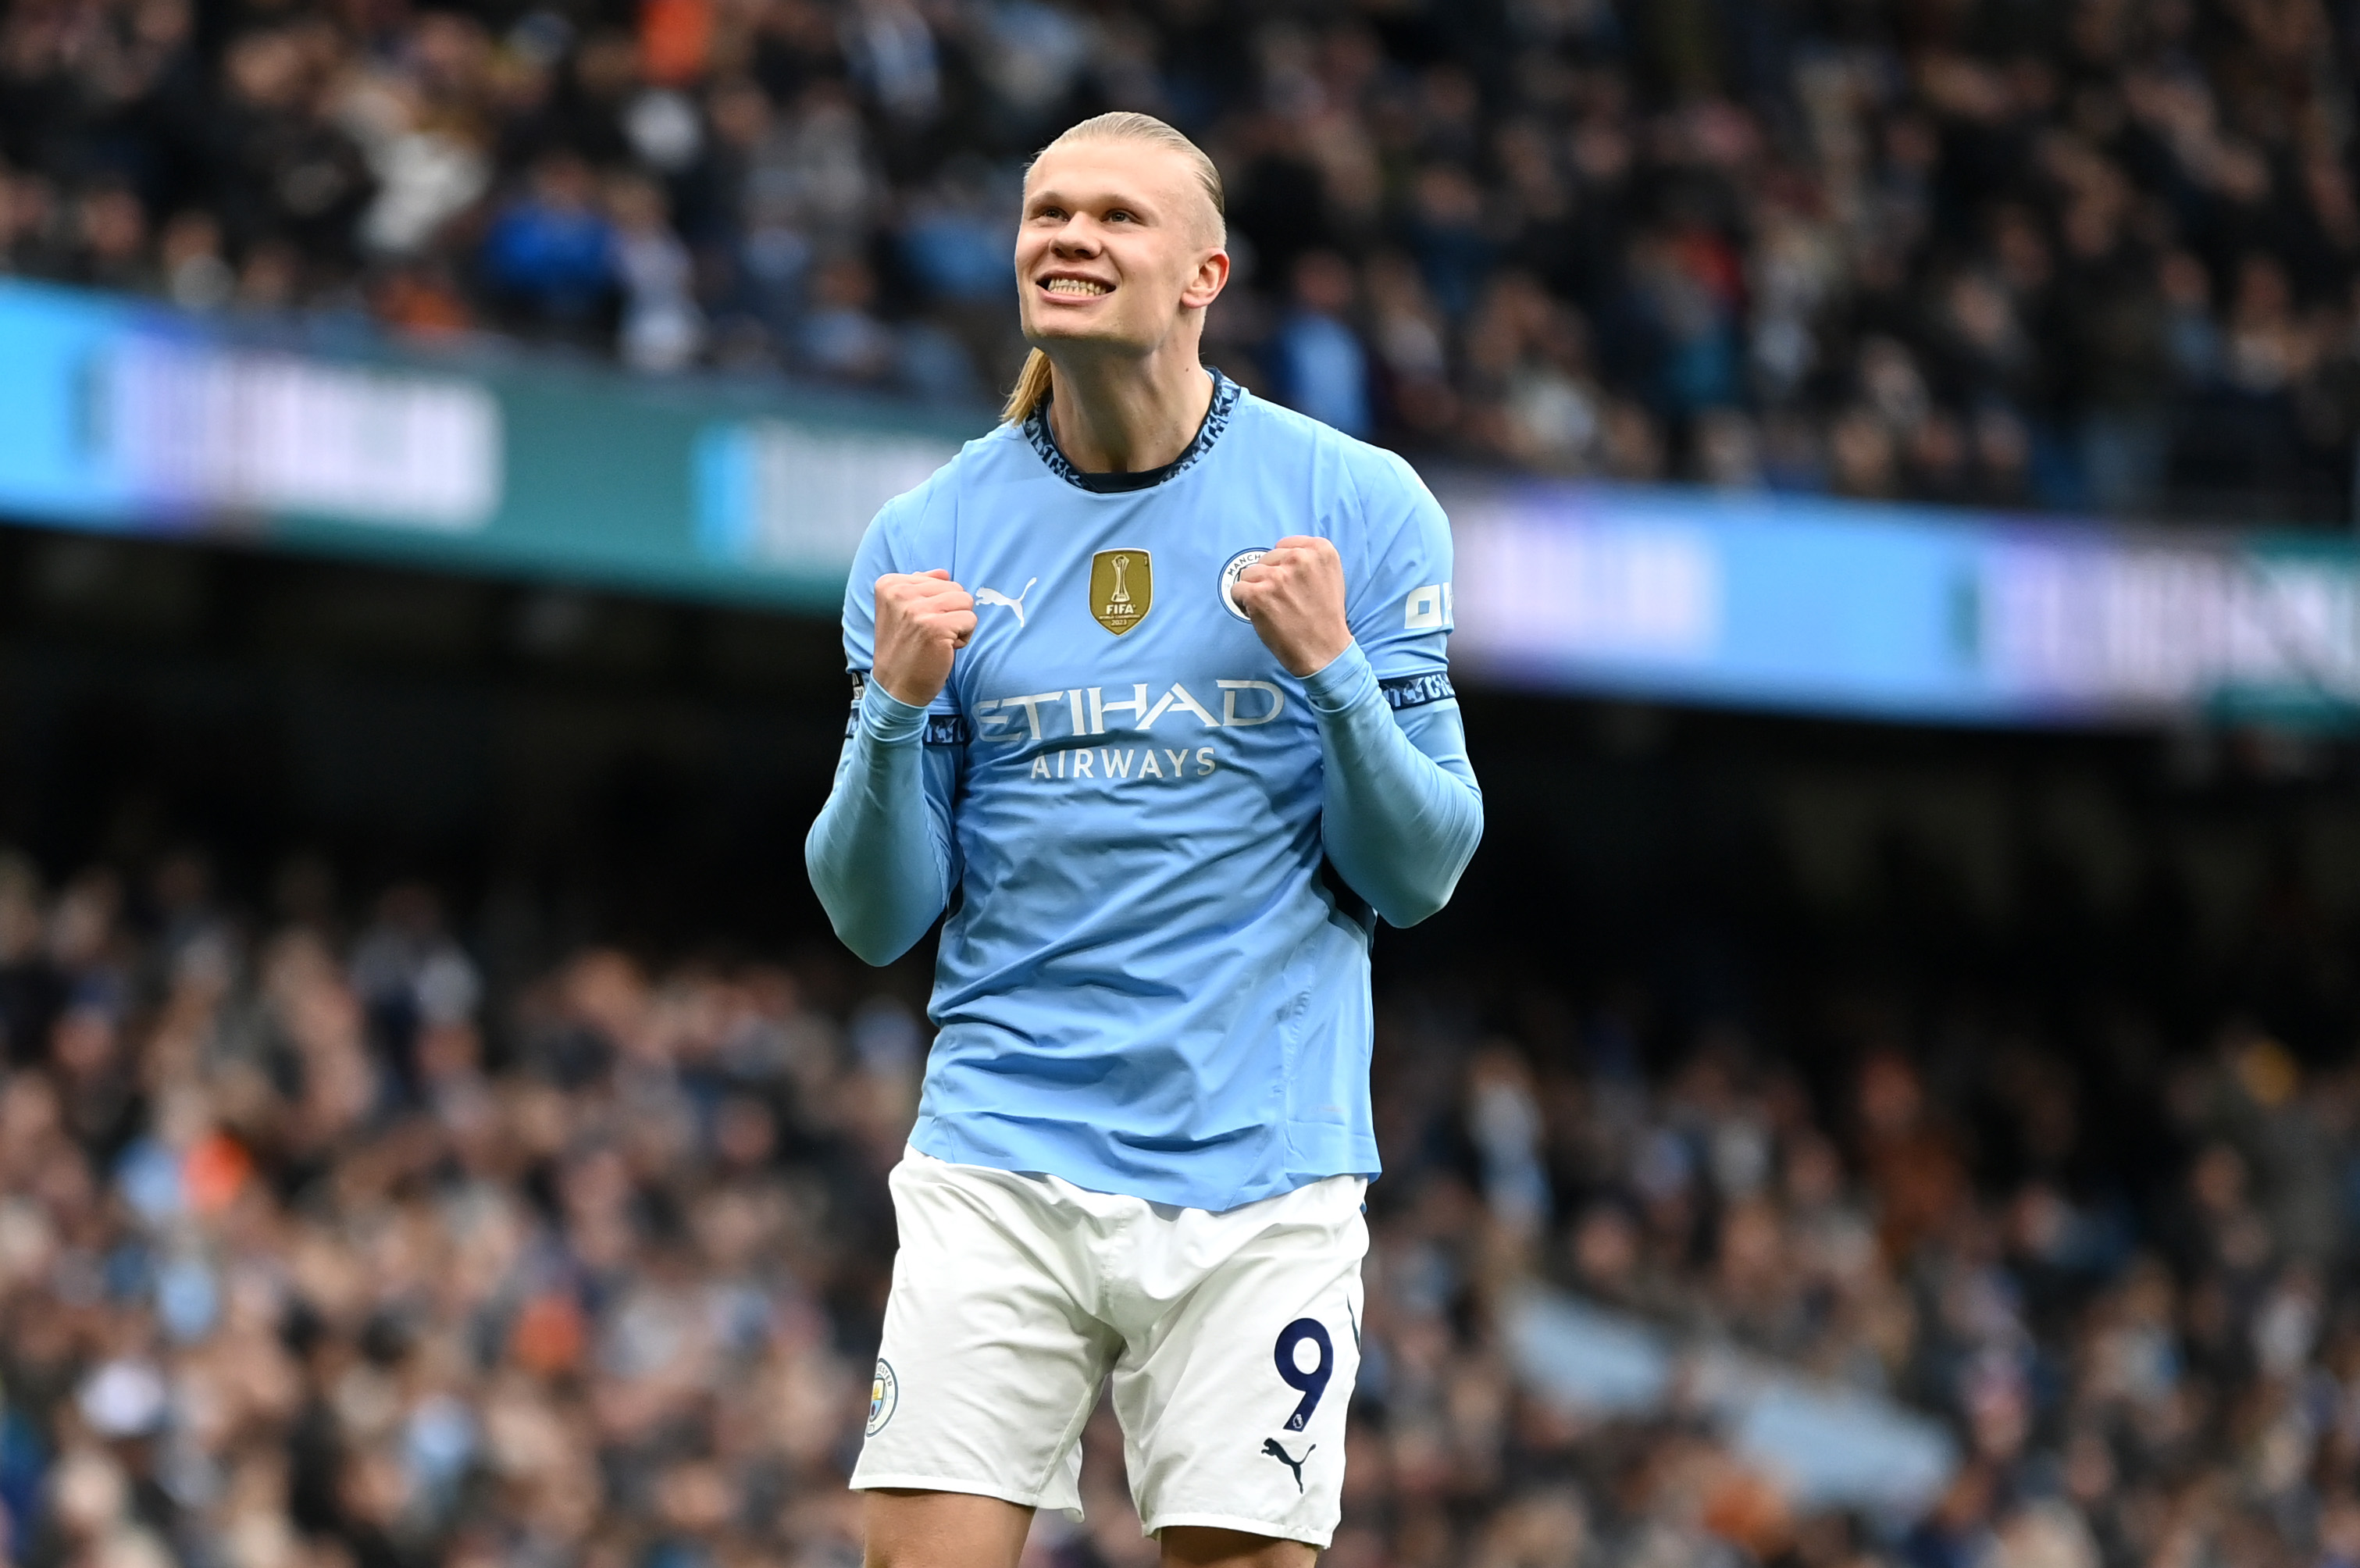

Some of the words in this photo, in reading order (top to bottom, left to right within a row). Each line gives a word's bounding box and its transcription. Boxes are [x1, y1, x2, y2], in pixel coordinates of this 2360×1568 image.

[1106, 604, 1134, 615] FIFA
[973, 679, 1285, 742] ETIHAD
[1030, 747, 1216, 779] AIRWAYS
[1274, 1317, 1334, 1433] 9
